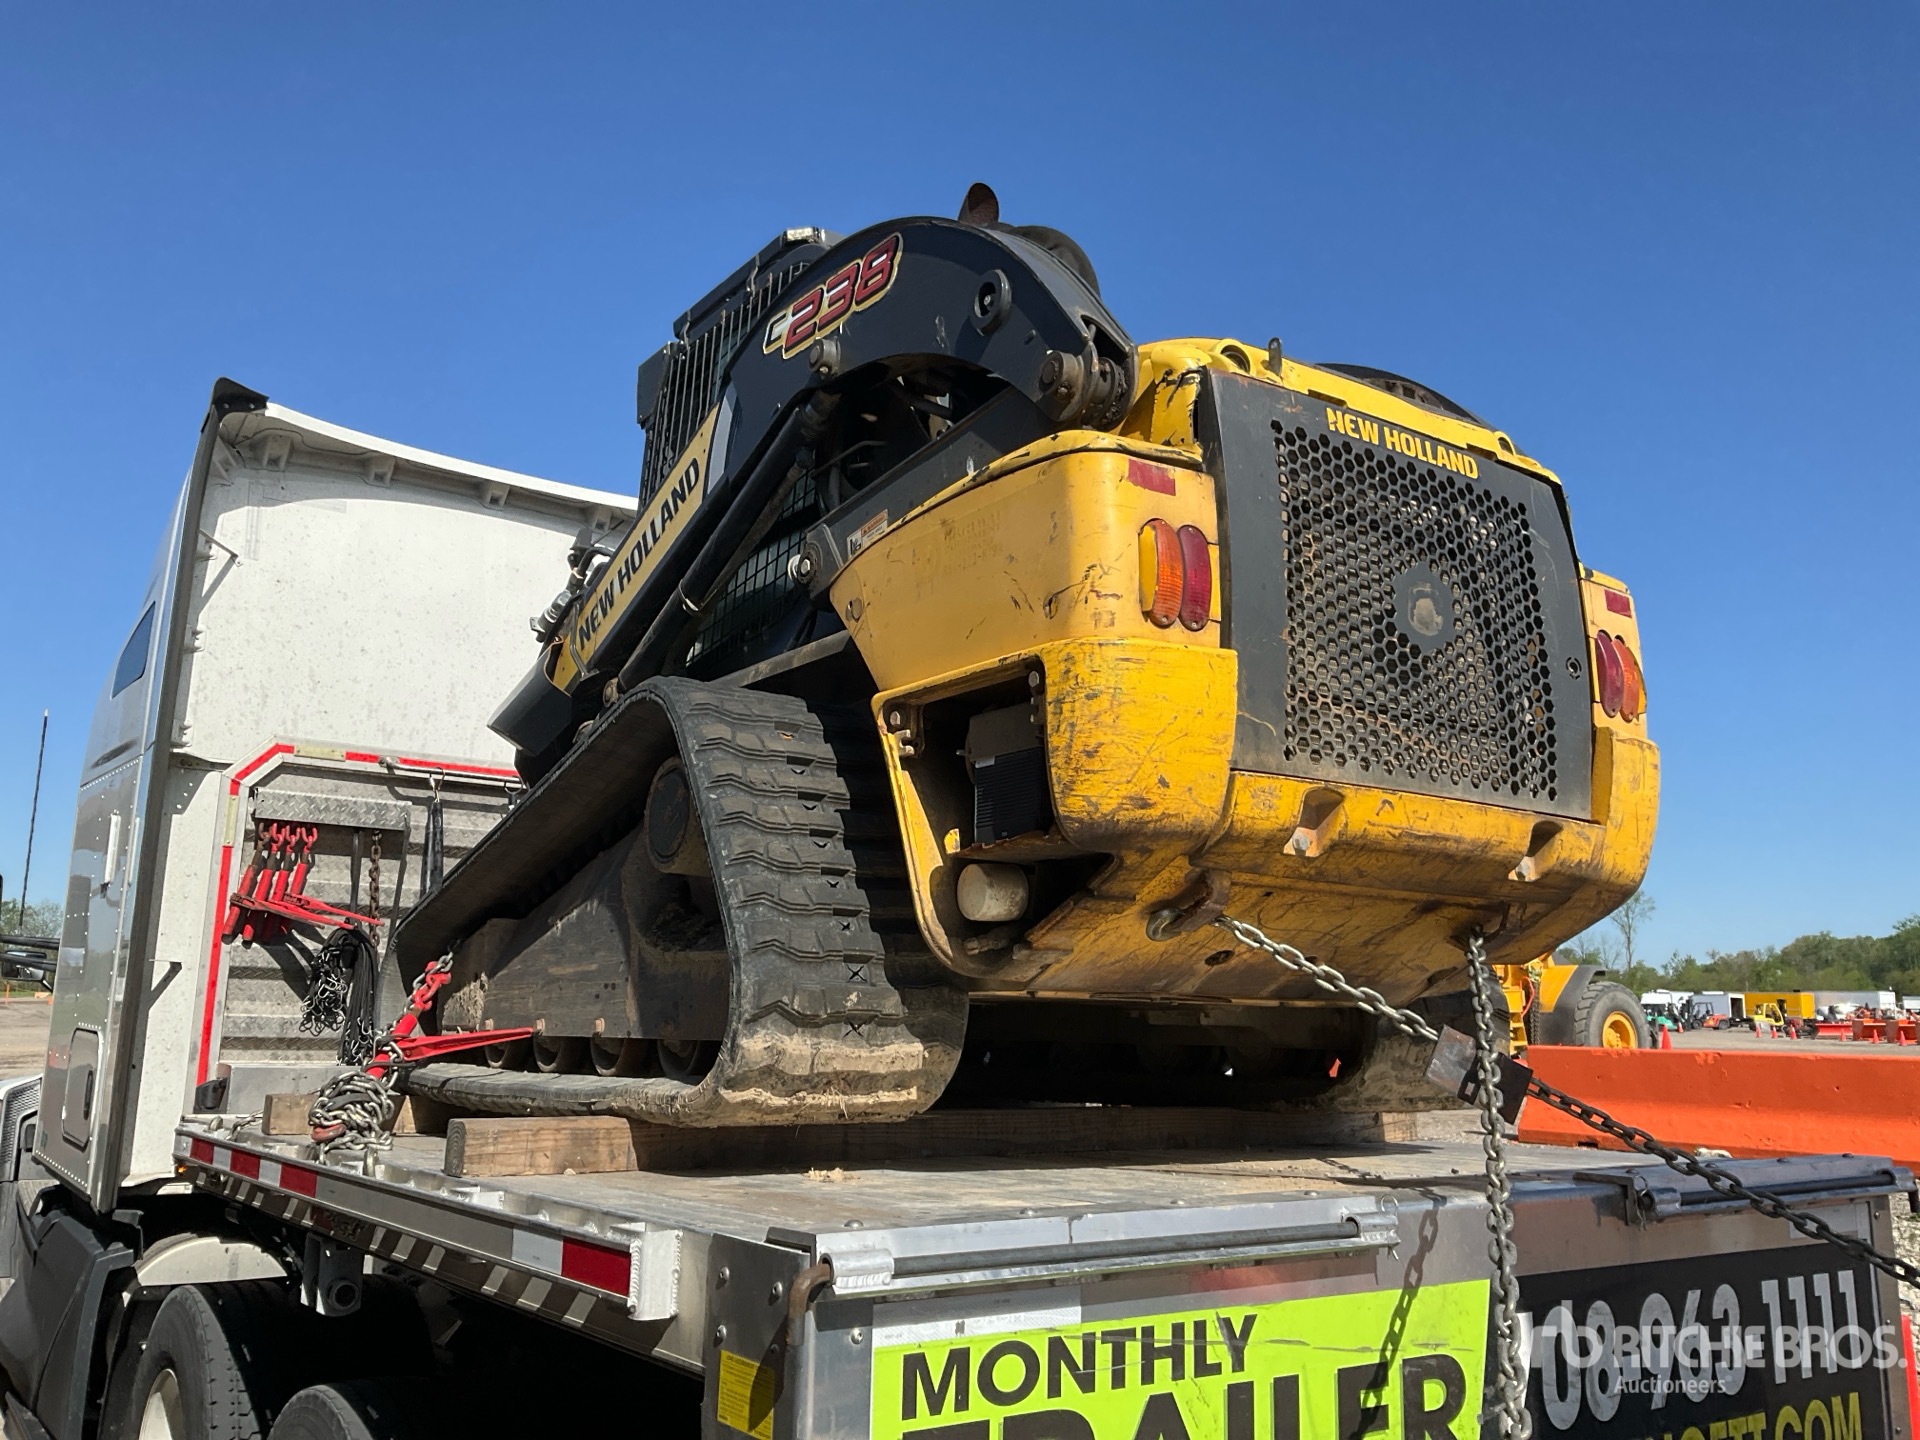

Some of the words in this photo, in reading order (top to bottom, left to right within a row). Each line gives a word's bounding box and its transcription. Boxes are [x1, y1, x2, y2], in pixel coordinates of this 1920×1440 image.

[764, 233, 902, 358] C238
[1326, 407, 1379, 445] NEW
[1384, 427, 1479, 479] HOLLAND
[578, 578, 614, 650] NEW
[617, 457, 699, 593] HOLLAND
[902, 1314, 1257, 1421] MONTHLY
